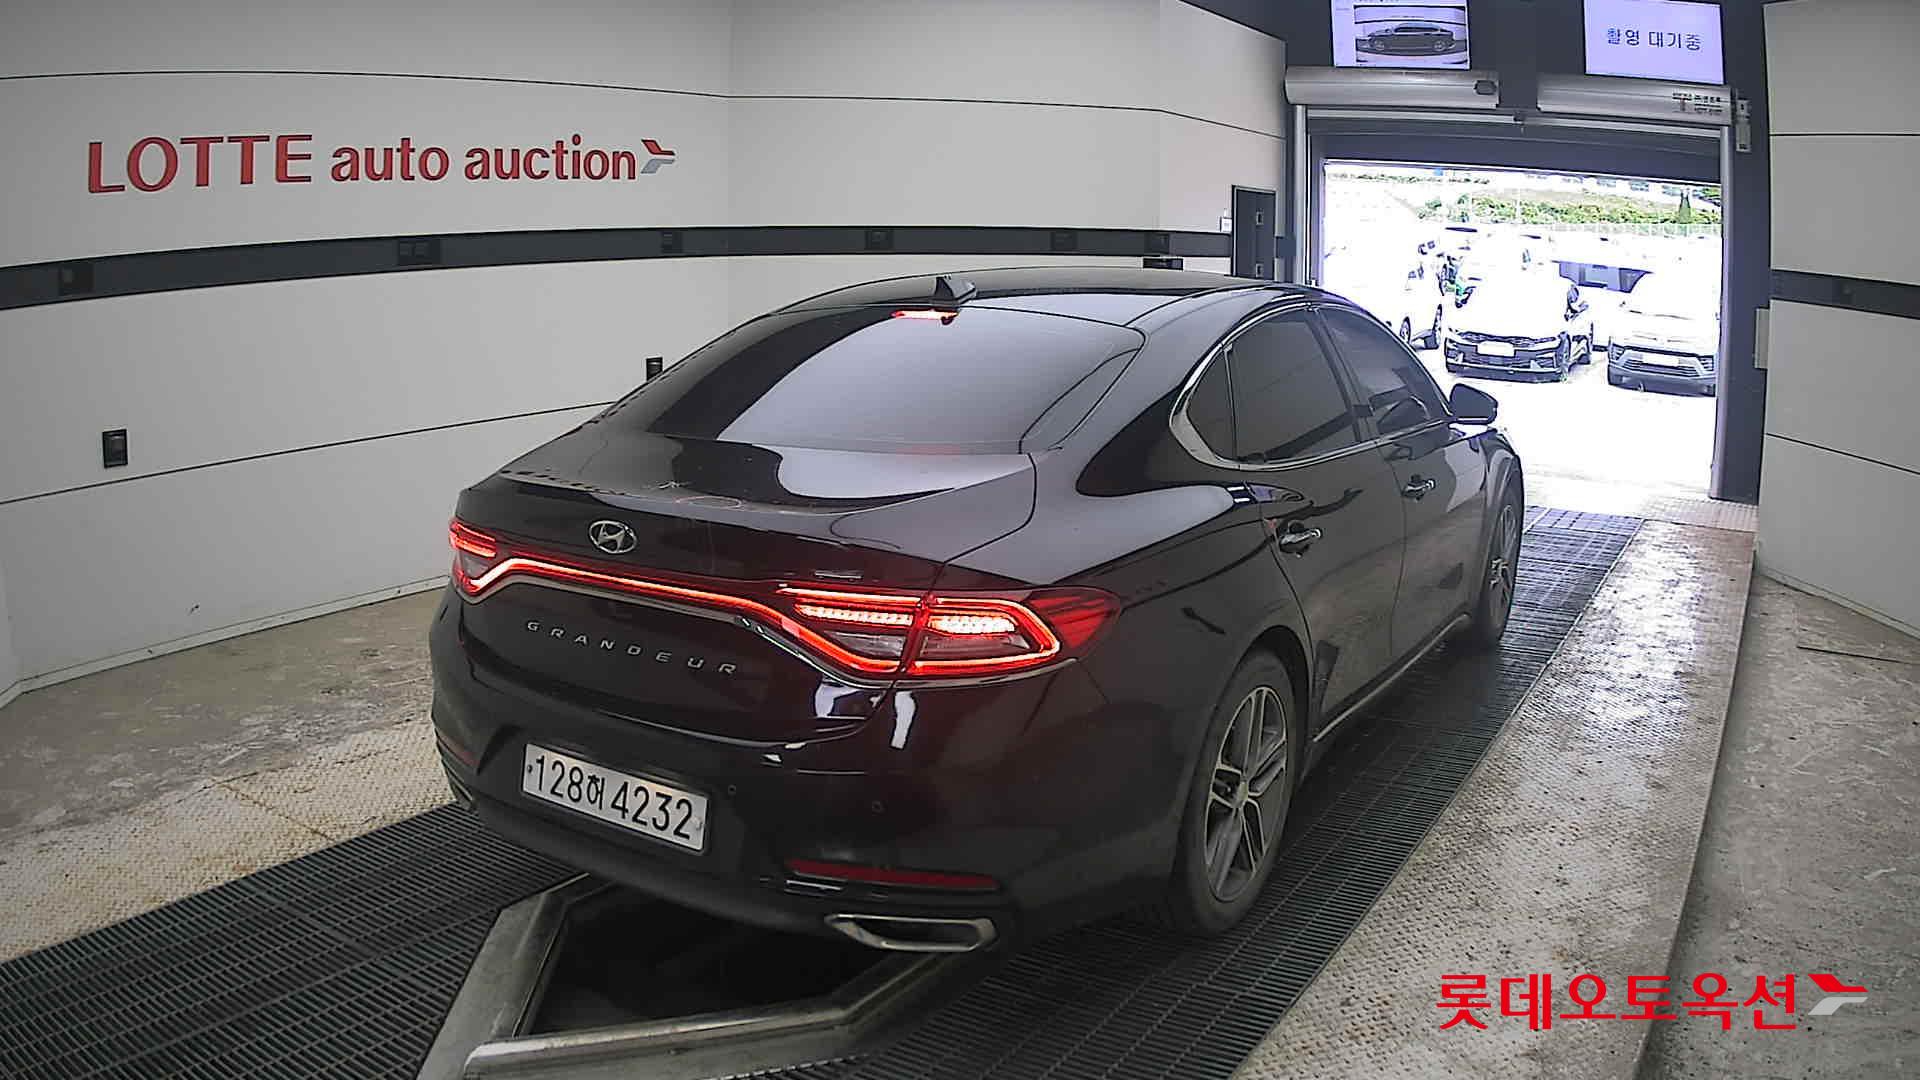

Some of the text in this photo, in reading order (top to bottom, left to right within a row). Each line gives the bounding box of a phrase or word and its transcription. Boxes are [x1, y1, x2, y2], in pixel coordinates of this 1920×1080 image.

[1647, 31, 1701, 51] 대기중
[88, 134, 636, 194] LOTTE auto auction
[527, 620, 737, 675] GRANDEUR
